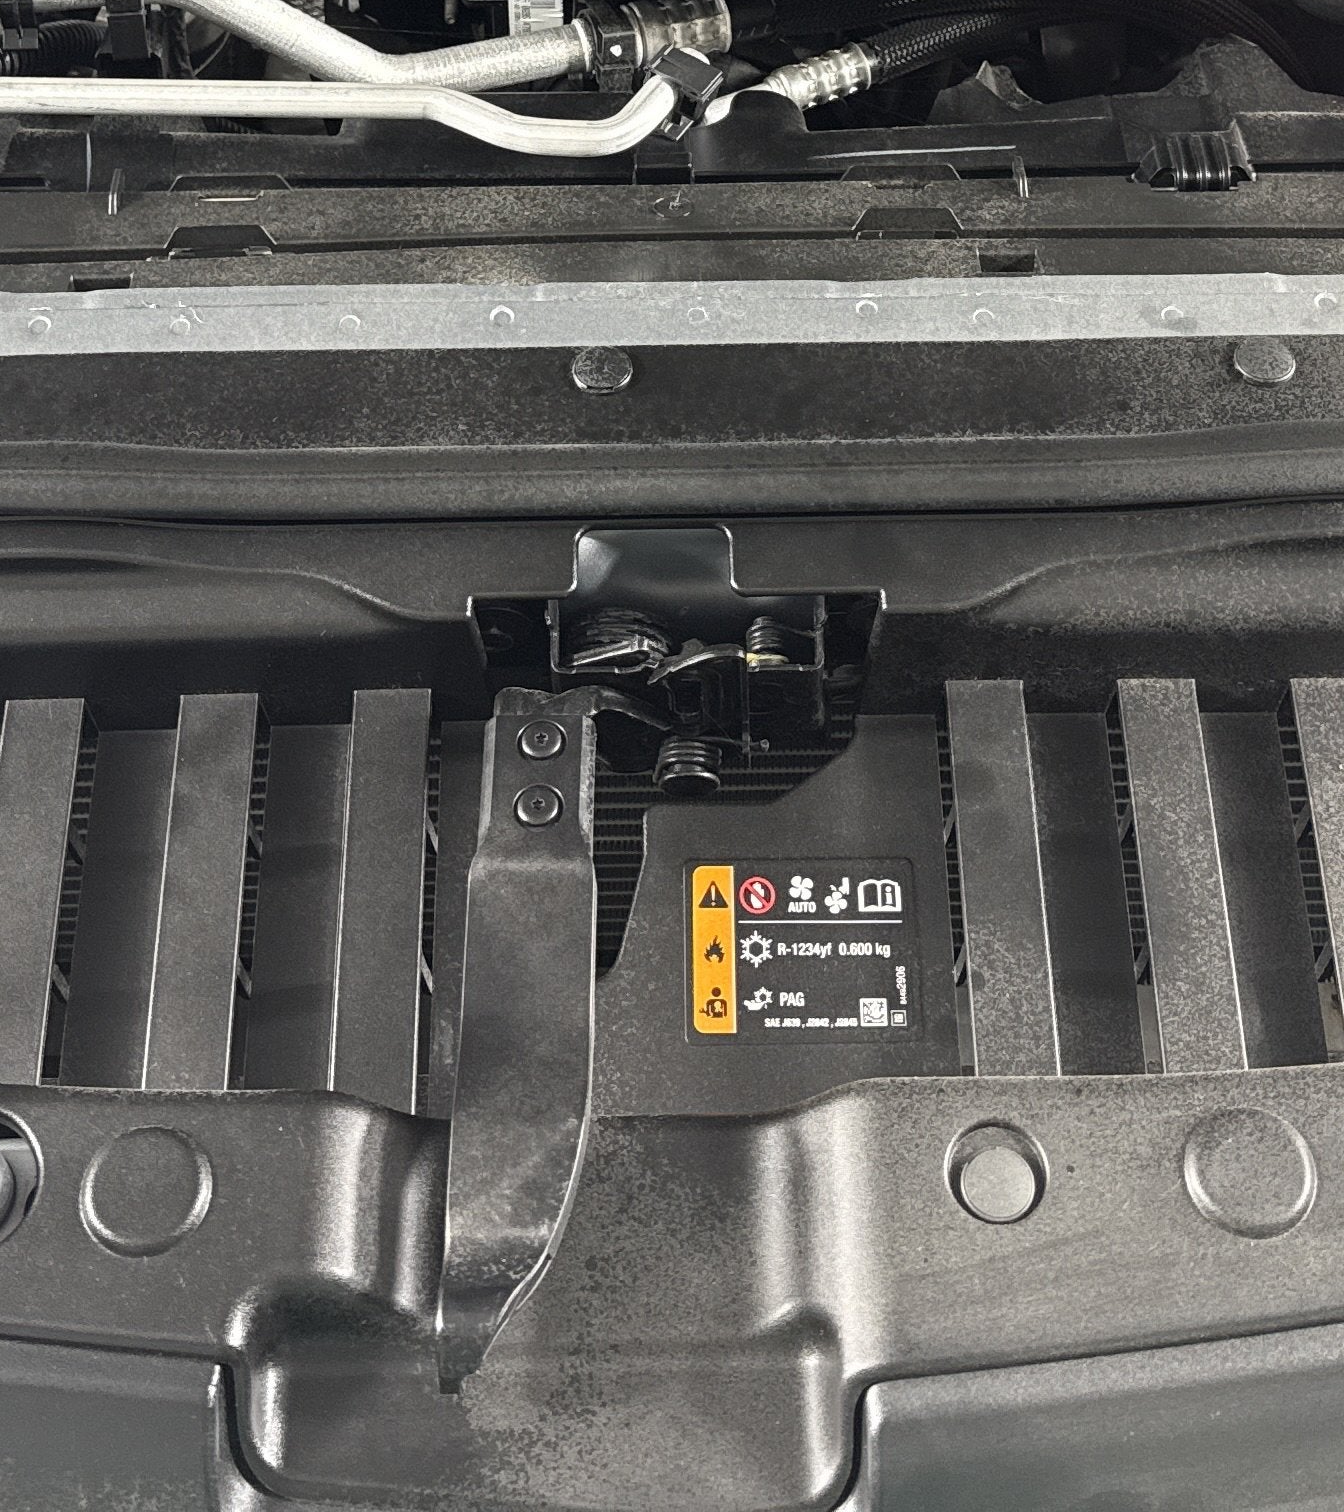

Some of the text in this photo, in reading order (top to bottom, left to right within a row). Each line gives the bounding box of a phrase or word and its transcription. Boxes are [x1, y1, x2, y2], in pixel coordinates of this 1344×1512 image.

[787, 901, 817, 914] AUTO
[777, 941, 891, 958] R-1234yf 0.600 kg
[779, 991, 806, 1007] PAG
[764, 1017, 781, 1028] SAE
